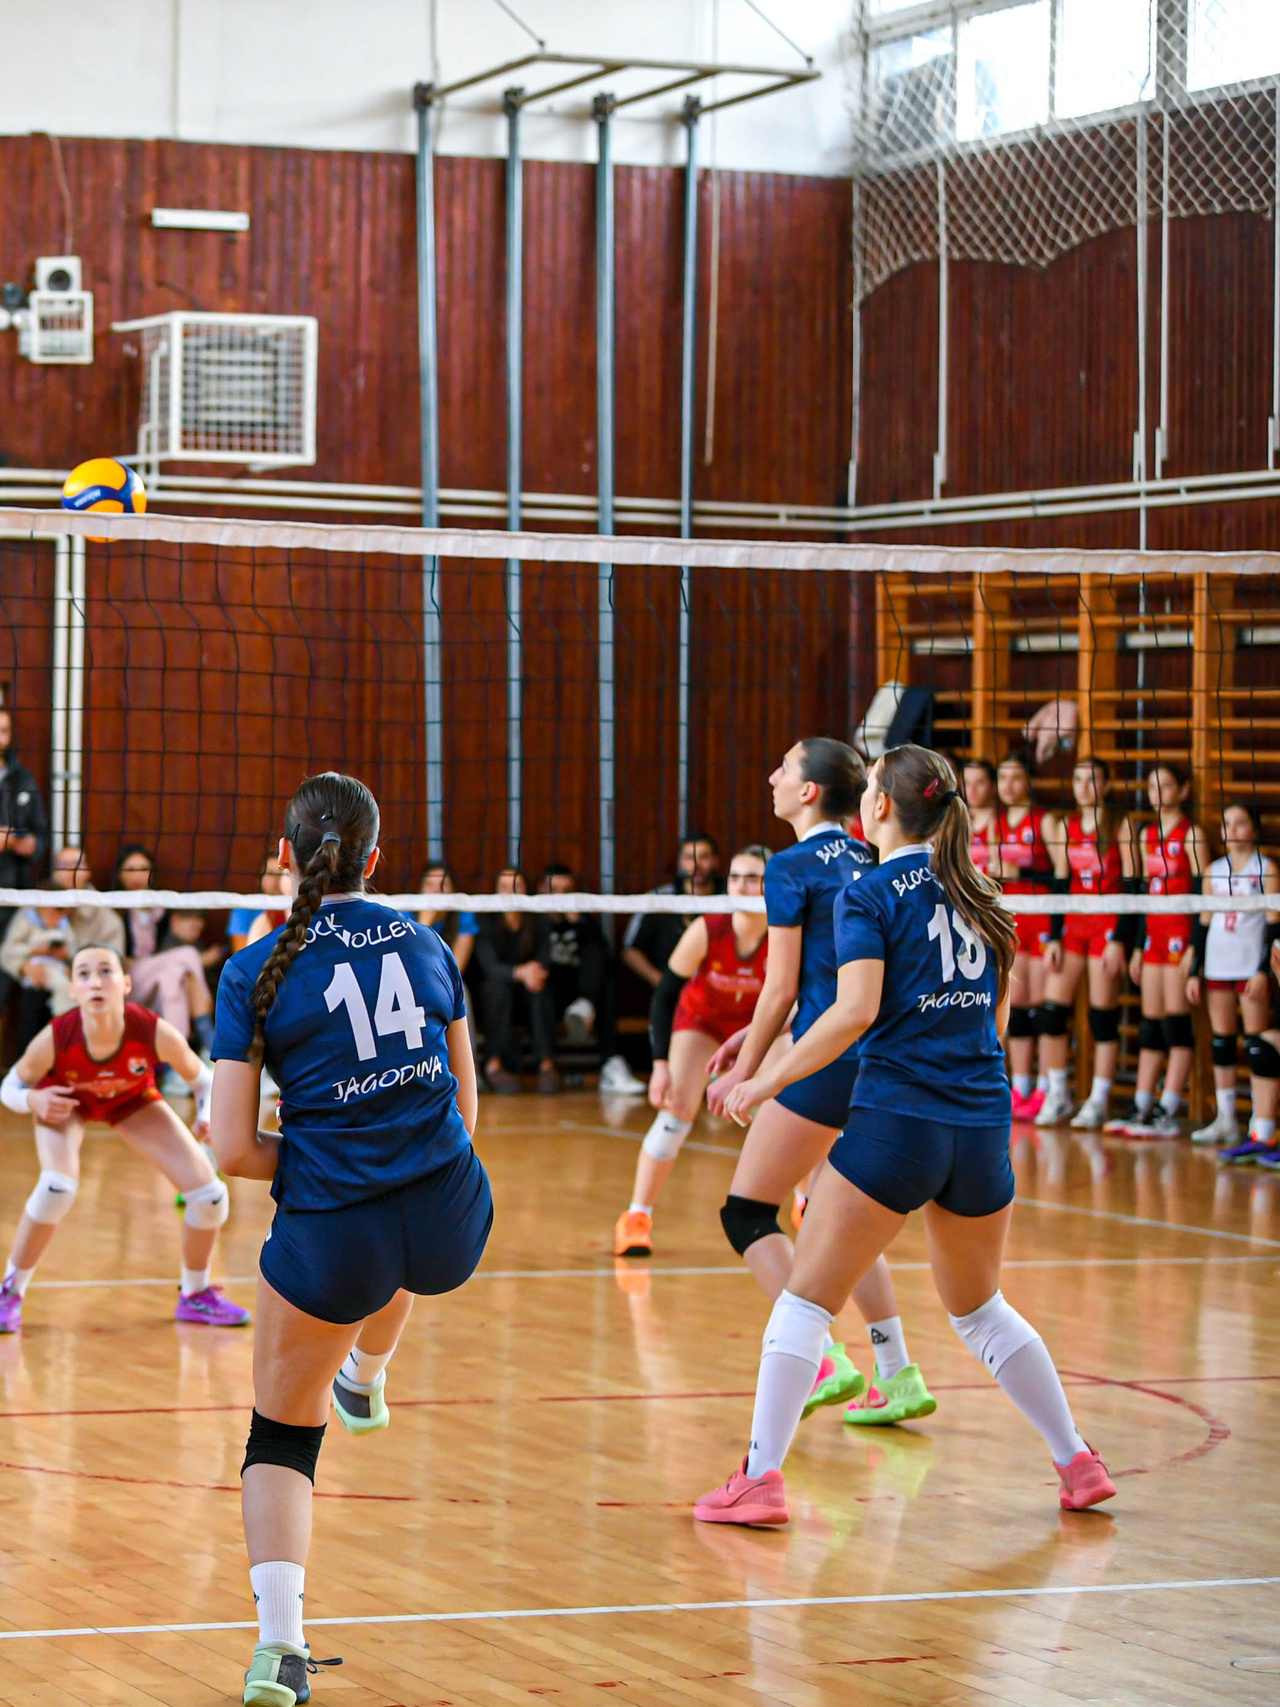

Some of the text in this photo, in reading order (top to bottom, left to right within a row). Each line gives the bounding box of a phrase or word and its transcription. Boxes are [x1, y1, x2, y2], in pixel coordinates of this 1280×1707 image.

[335, 921, 417, 948] VOLLEY
[323, 951, 427, 1062] 14
[332, 1055, 443, 1103] JAGODINA
